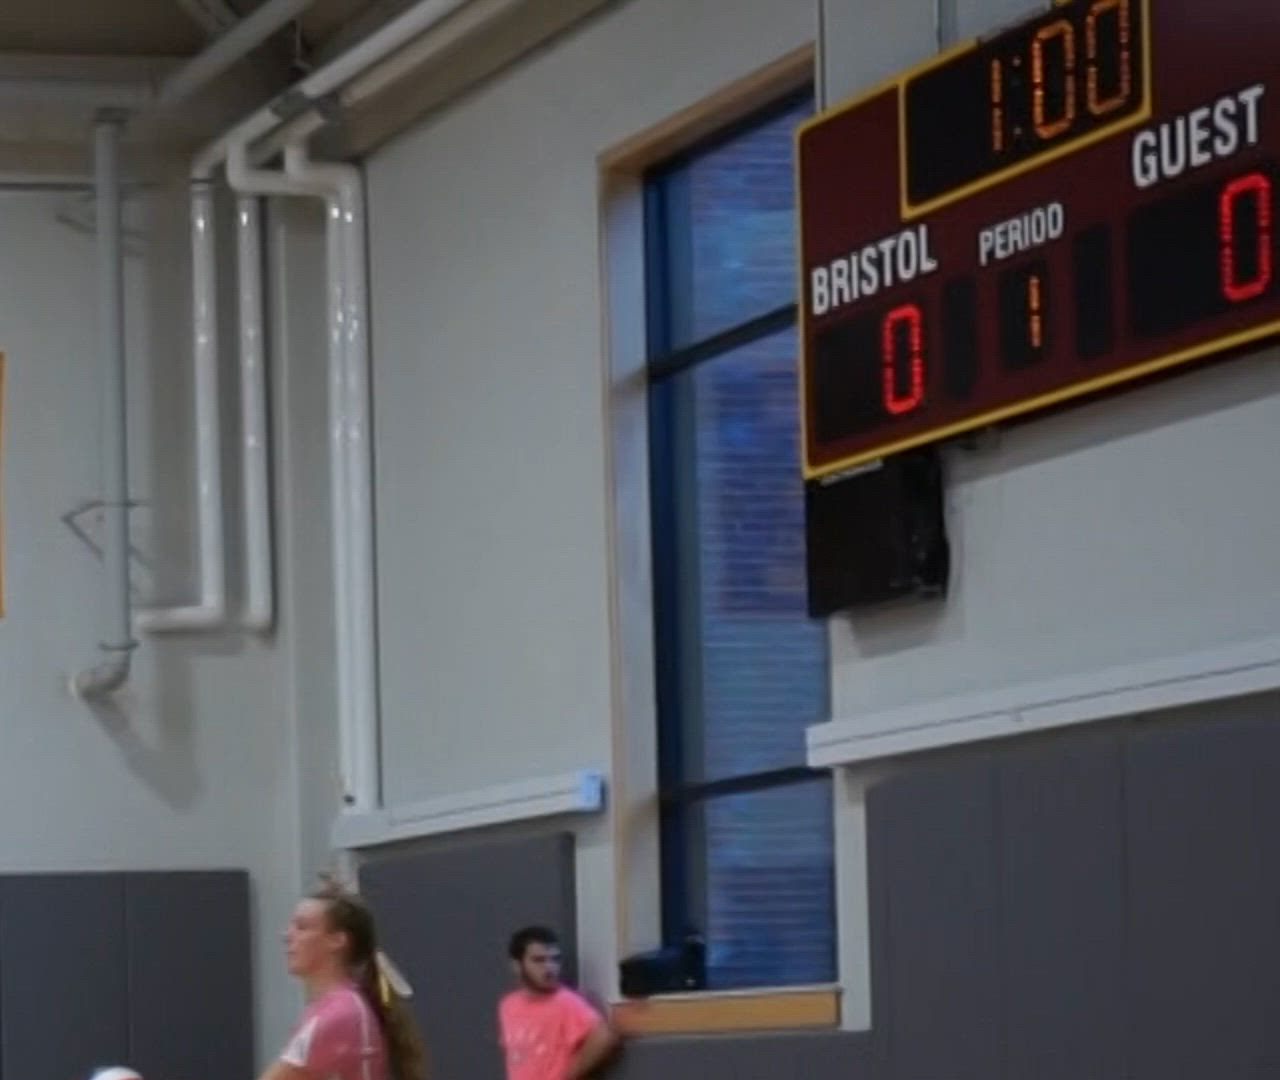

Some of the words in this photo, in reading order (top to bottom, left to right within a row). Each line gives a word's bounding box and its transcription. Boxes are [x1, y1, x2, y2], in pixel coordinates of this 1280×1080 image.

[1132, 84, 1265, 187] GUEST
[811, 223, 937, 315] BRISTOL
[979, 202, 1065, 266] PERIOD
[1219, 173, 1271, 300] 0
[883, 304, 923, 414] 0
[1029, 276, 1041, 347] 1
